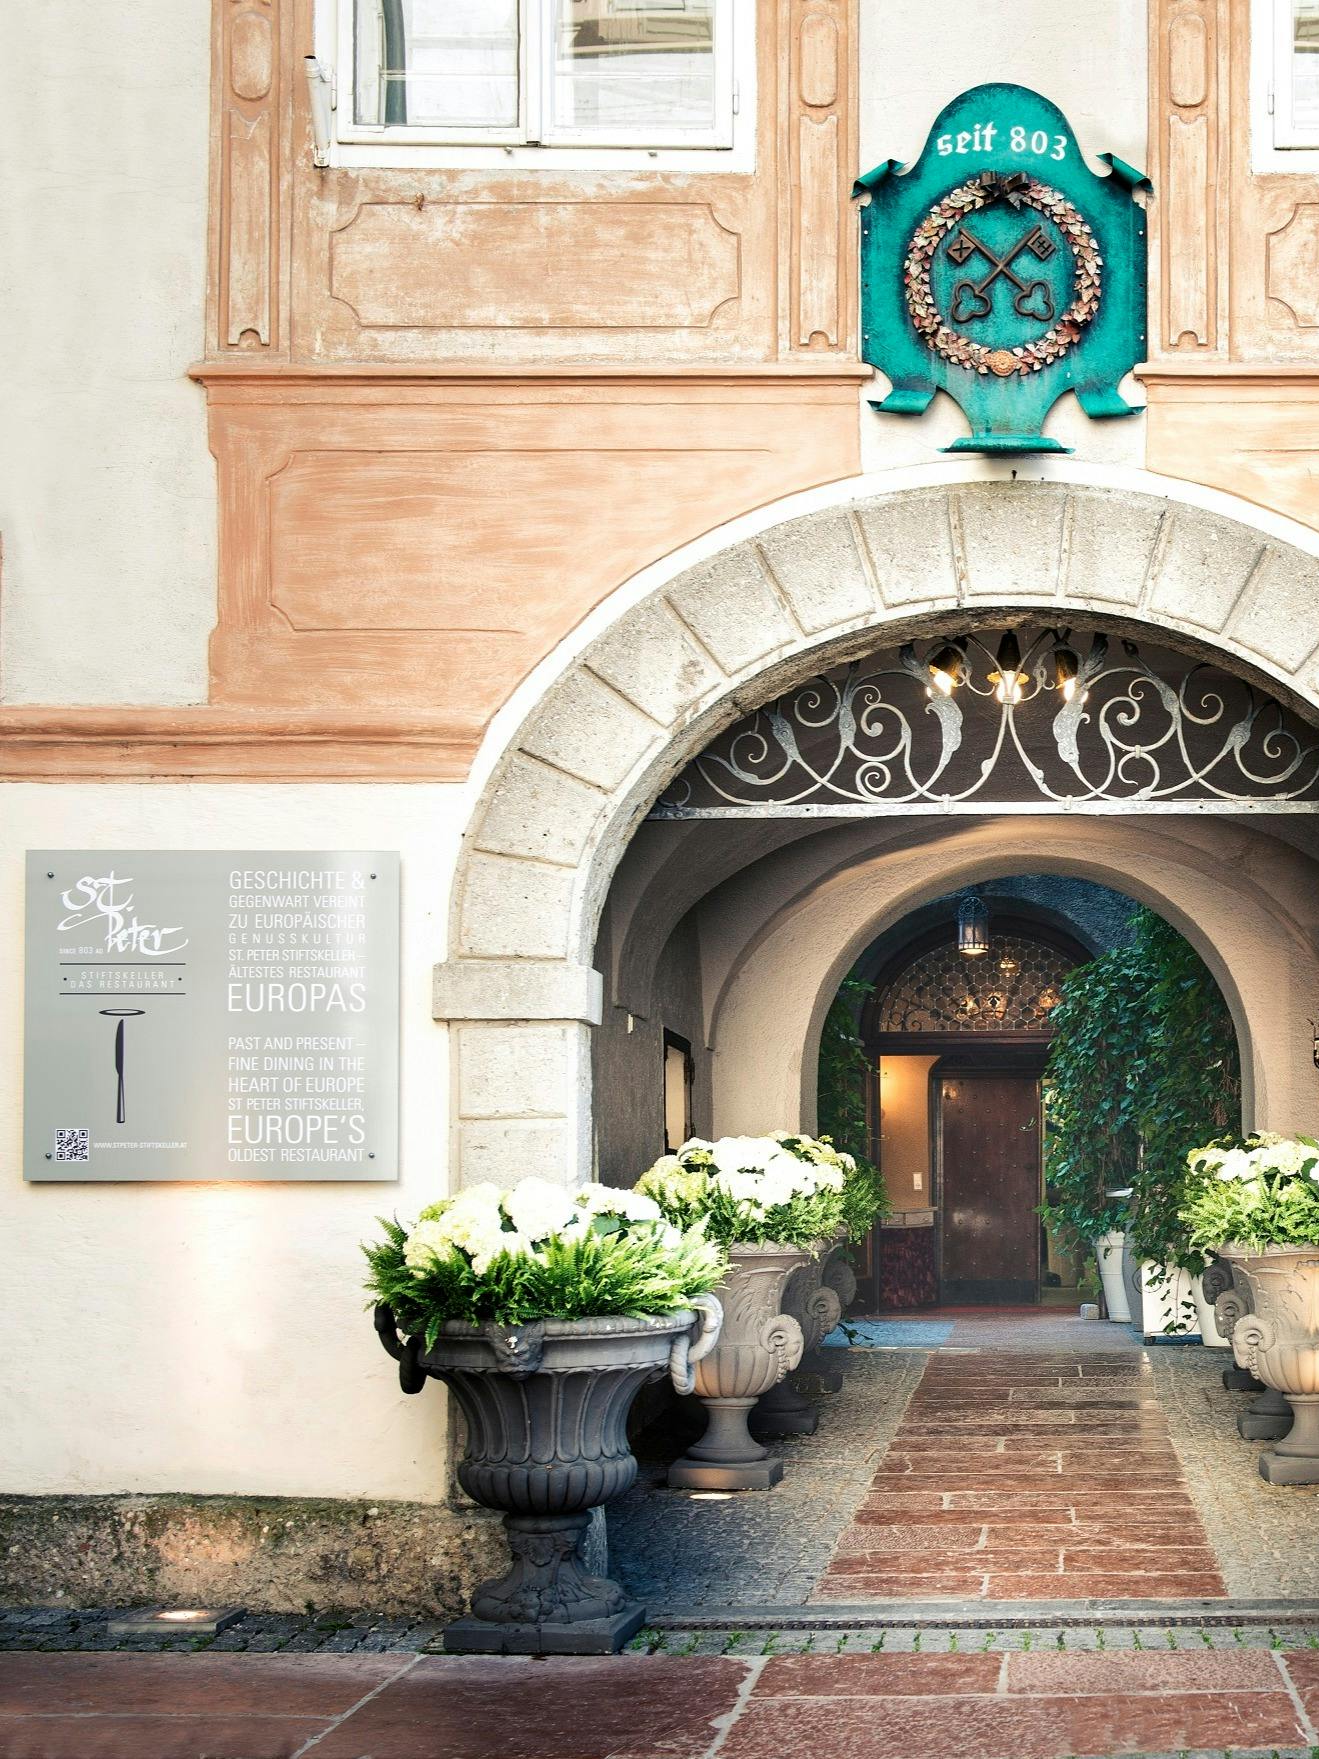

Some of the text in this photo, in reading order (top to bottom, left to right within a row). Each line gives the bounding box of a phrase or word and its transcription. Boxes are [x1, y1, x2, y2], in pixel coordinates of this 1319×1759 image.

[937, 121, 1068, 161] seit 803
[229, 870, 365, 889] GESCHICHTE &
[229, 895, 366, 908] GEGENWART VEREINT
[228, 911, 366, 929] ZU EUROPÄISCHER
[247, 949, 280, 961] PETER
[282, 949, 356, 961] STIFTSKELLER
[81, 971, 164, 980] STIFTSKELLER
[228, 964, 366, 978] ÄLTESTES RESTAURANT
[70, 980, 175, 989] DAS RESTAURANT
[228, 983, 366, 1012] EUROPAS
[228, 1036, 261, 1050] PAST
[263, 1036, 293, 1050] AND
[296, 1036, 354, 1050] PRESENT
[228, 1056, 366, 1071] FINE DINING IN THE
[228, 1077, 366, 1093] HEART OF EUROPE
[228, 1097, 243, 1111] ST
[247, 1097, 281, 1111] PETER
[228, 1114, 366, 1144] EUROPE'S
[228, 1148, 365, 1162] OLDEST RESTAURANT
